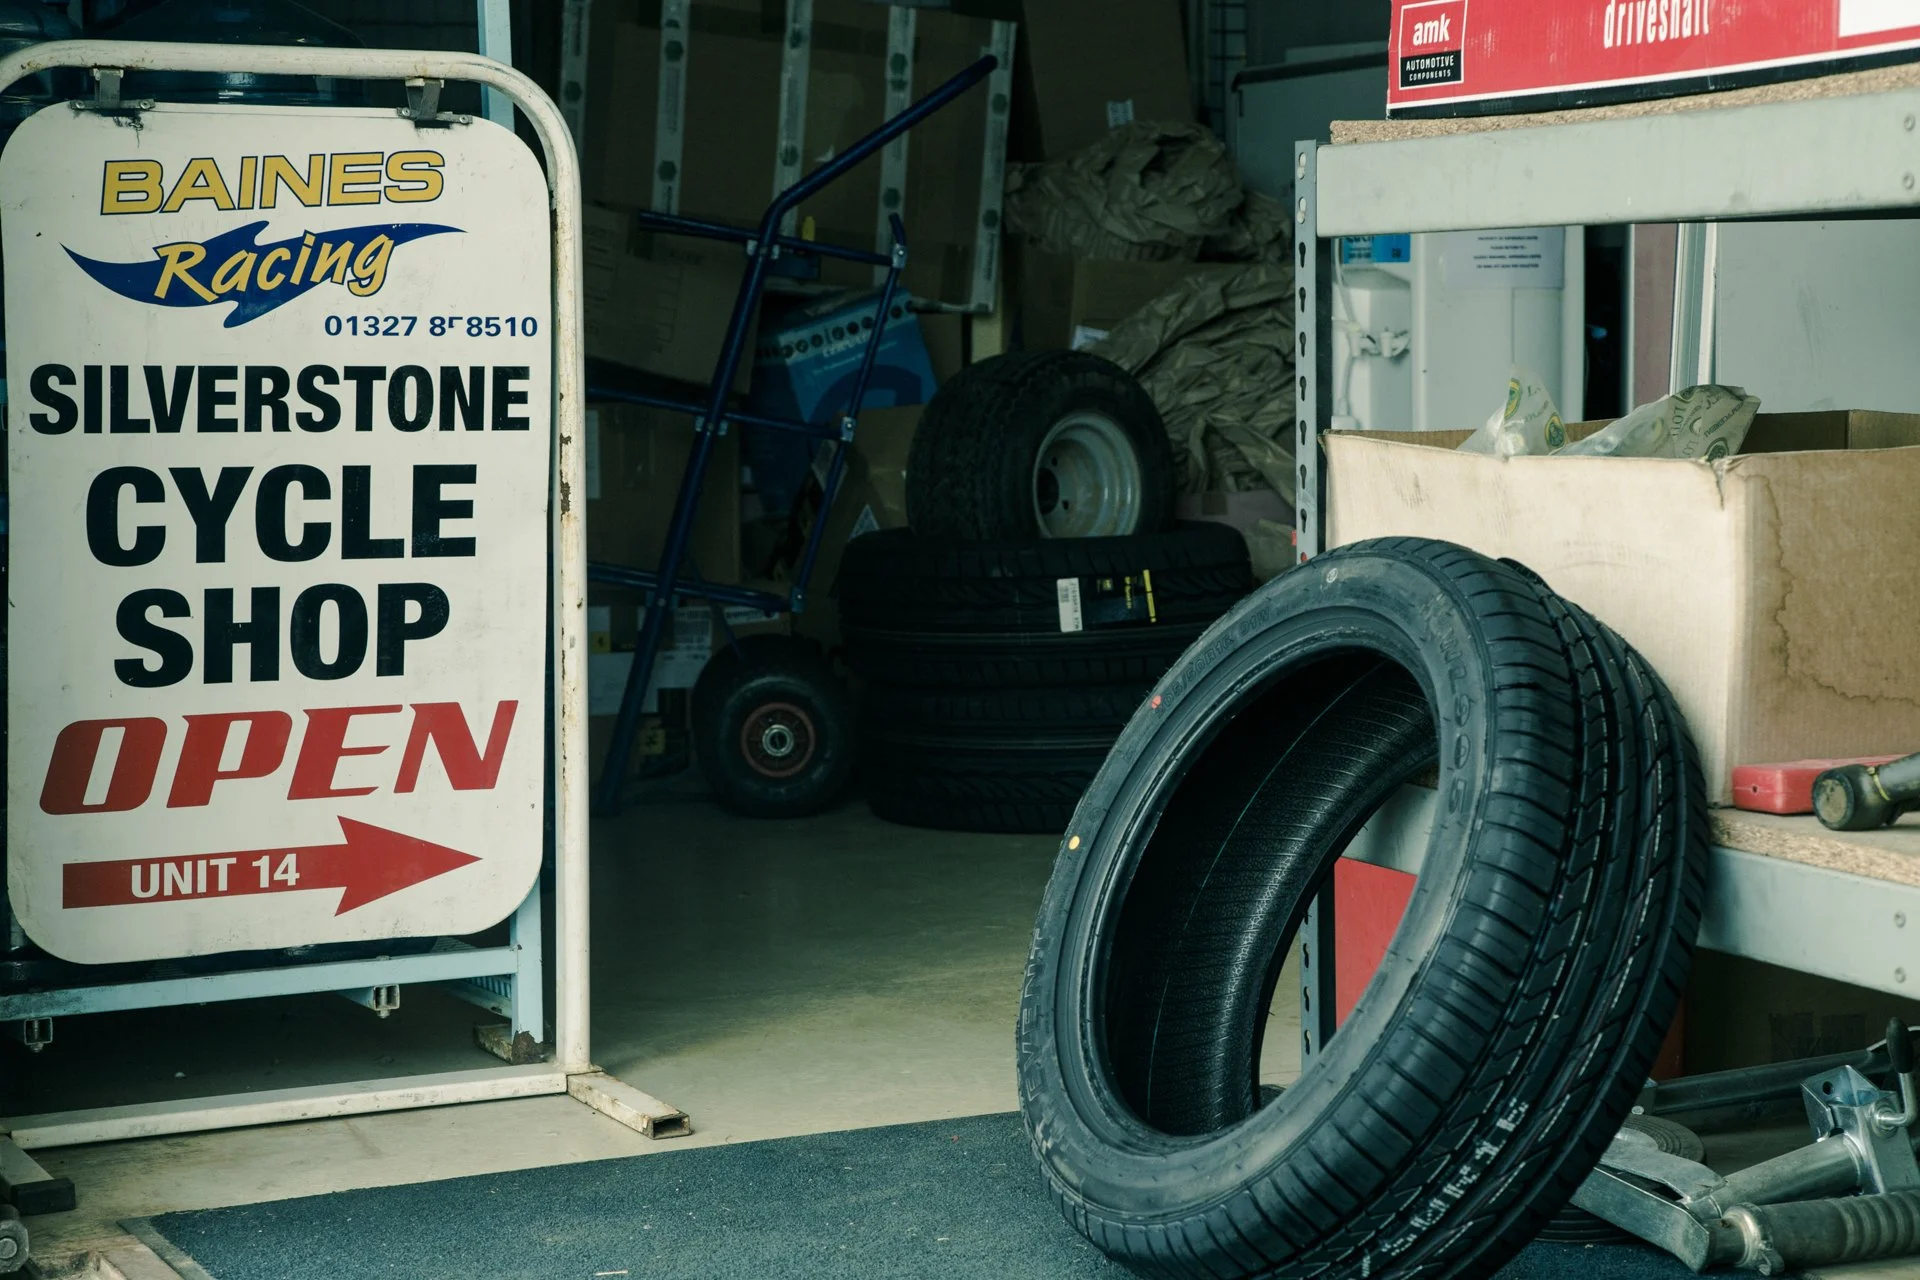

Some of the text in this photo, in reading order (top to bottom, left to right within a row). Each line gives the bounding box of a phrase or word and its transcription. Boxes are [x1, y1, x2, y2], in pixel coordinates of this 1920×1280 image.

[1405, 55, 1455, 71] AUTOMOTIVE
[1412, 13, 1451, 46] amk
[1409, 69, 1452, 81] COMPONENTS
[100, 150, 445, 216] BAINES
[152, 229, 395, 303] Racing
[324, 315, 418, 337] 01327
[29, 363, 531, 435] SILVERSTONE
[86, 463, 478, 567] CYCLE
[114, 582, 450, 688] SHOP
[39, 700, 519, 815] OPEN
[131, 853, 300, 898] UNIT 14
[1020, 925, 1048, 1103] EVENT
